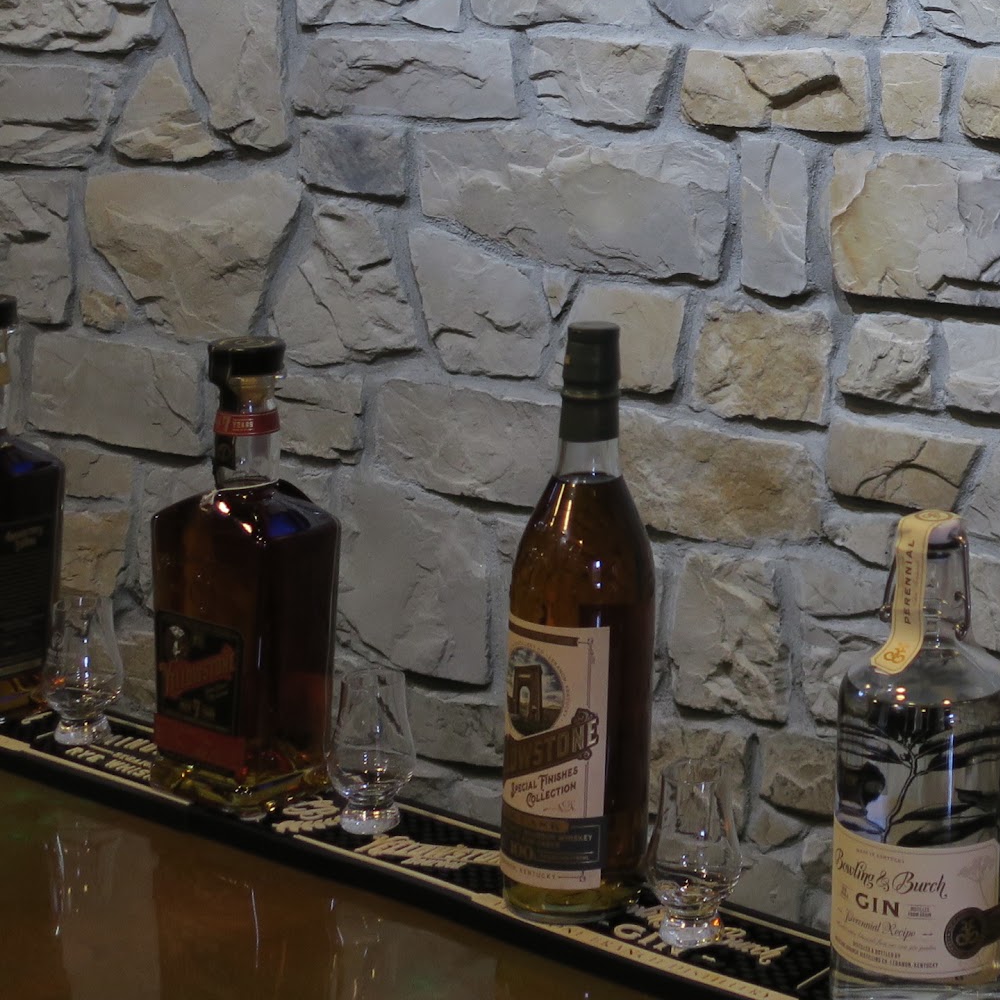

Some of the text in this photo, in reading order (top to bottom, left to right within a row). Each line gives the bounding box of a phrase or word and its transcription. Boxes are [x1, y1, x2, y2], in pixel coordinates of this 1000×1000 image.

[904, 540, 915, 625] PERENNIAL
[511, 766, 579, 798] SPECIAL FINISHES
[526, 781, 577, 807] COLLECTION
[835, 847, 948, 900] Bowling & Burch
[855, 892, 900, 918] GIN
